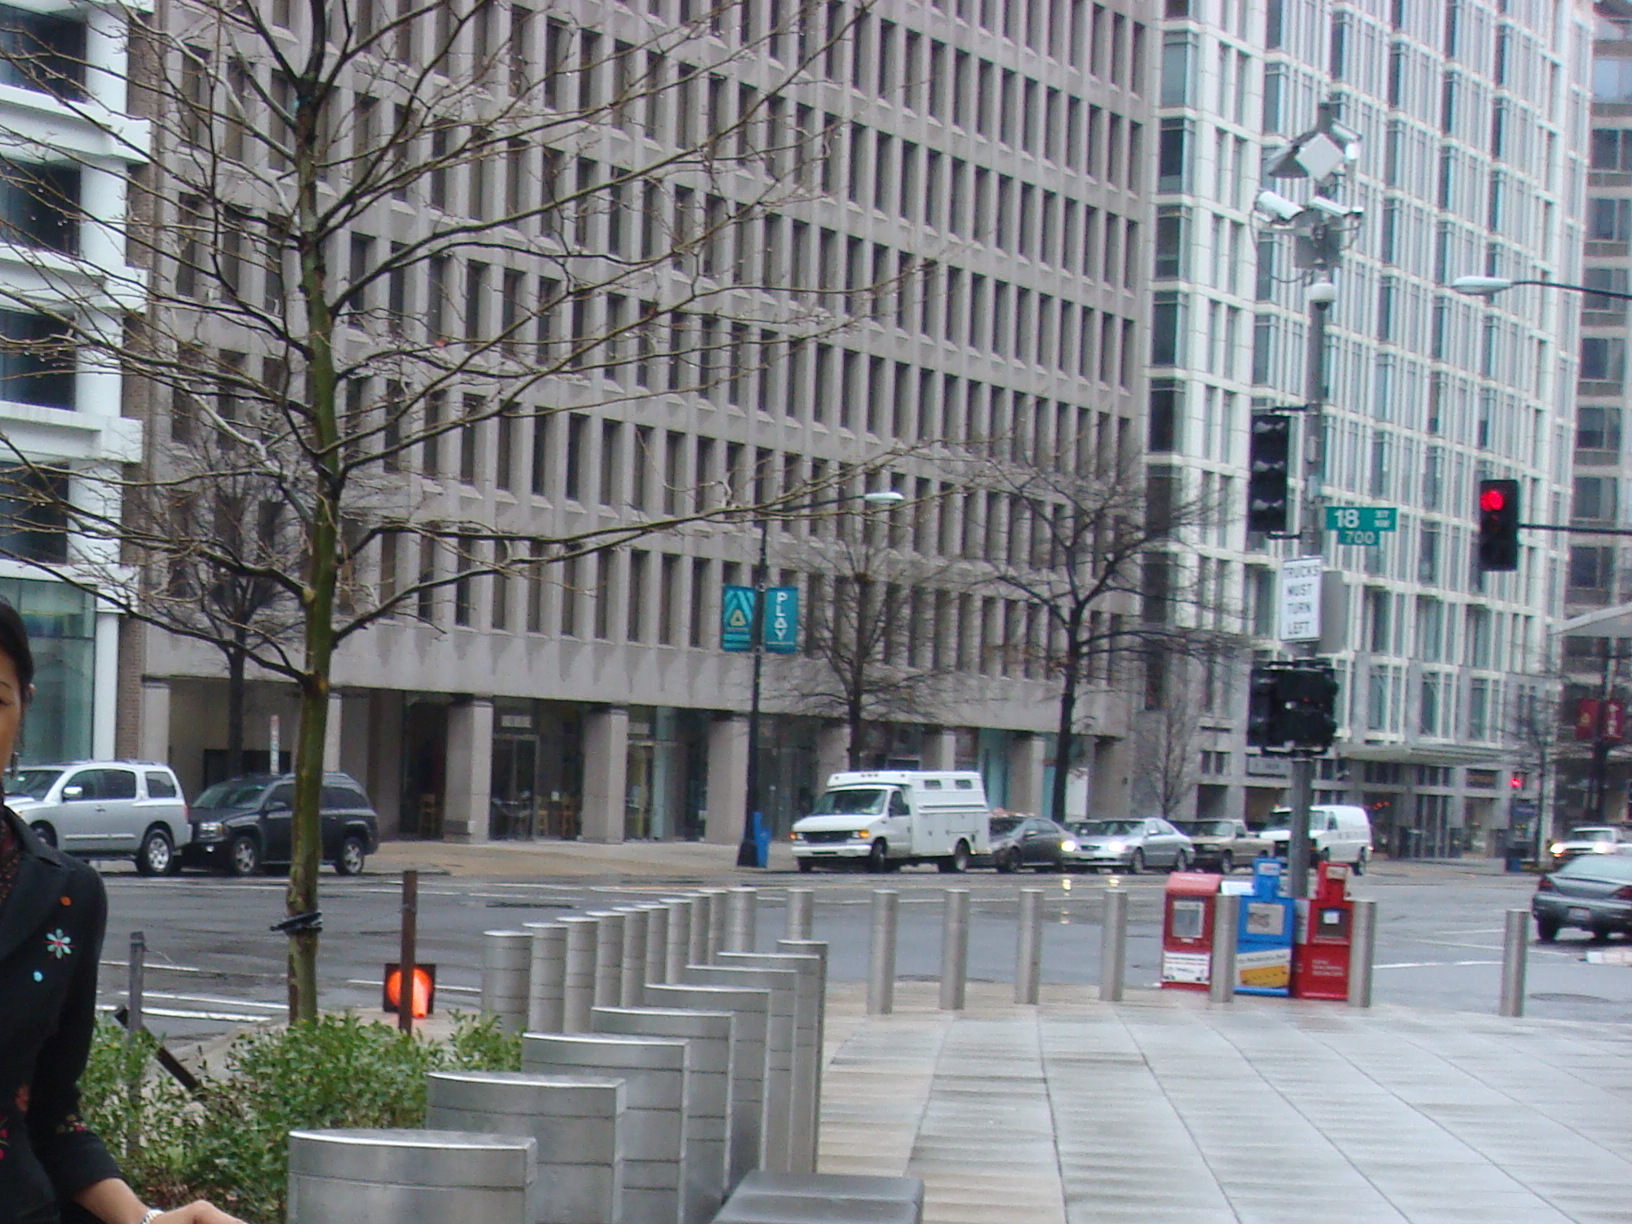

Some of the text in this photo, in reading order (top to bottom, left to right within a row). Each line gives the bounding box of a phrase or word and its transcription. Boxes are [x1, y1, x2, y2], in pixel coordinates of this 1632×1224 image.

[1334, 509, 1360, 528] 18
[1345, 531, 1375, 544] 700
[1283, 565, 1319, 578] TRUCKS
[1288, 584, 1312, 596] MUST
[1288, 602, 1311, 614] TURN
[774, 591, 788, 641] PLAY
[1288, 621, 1311, 634] LEFT
